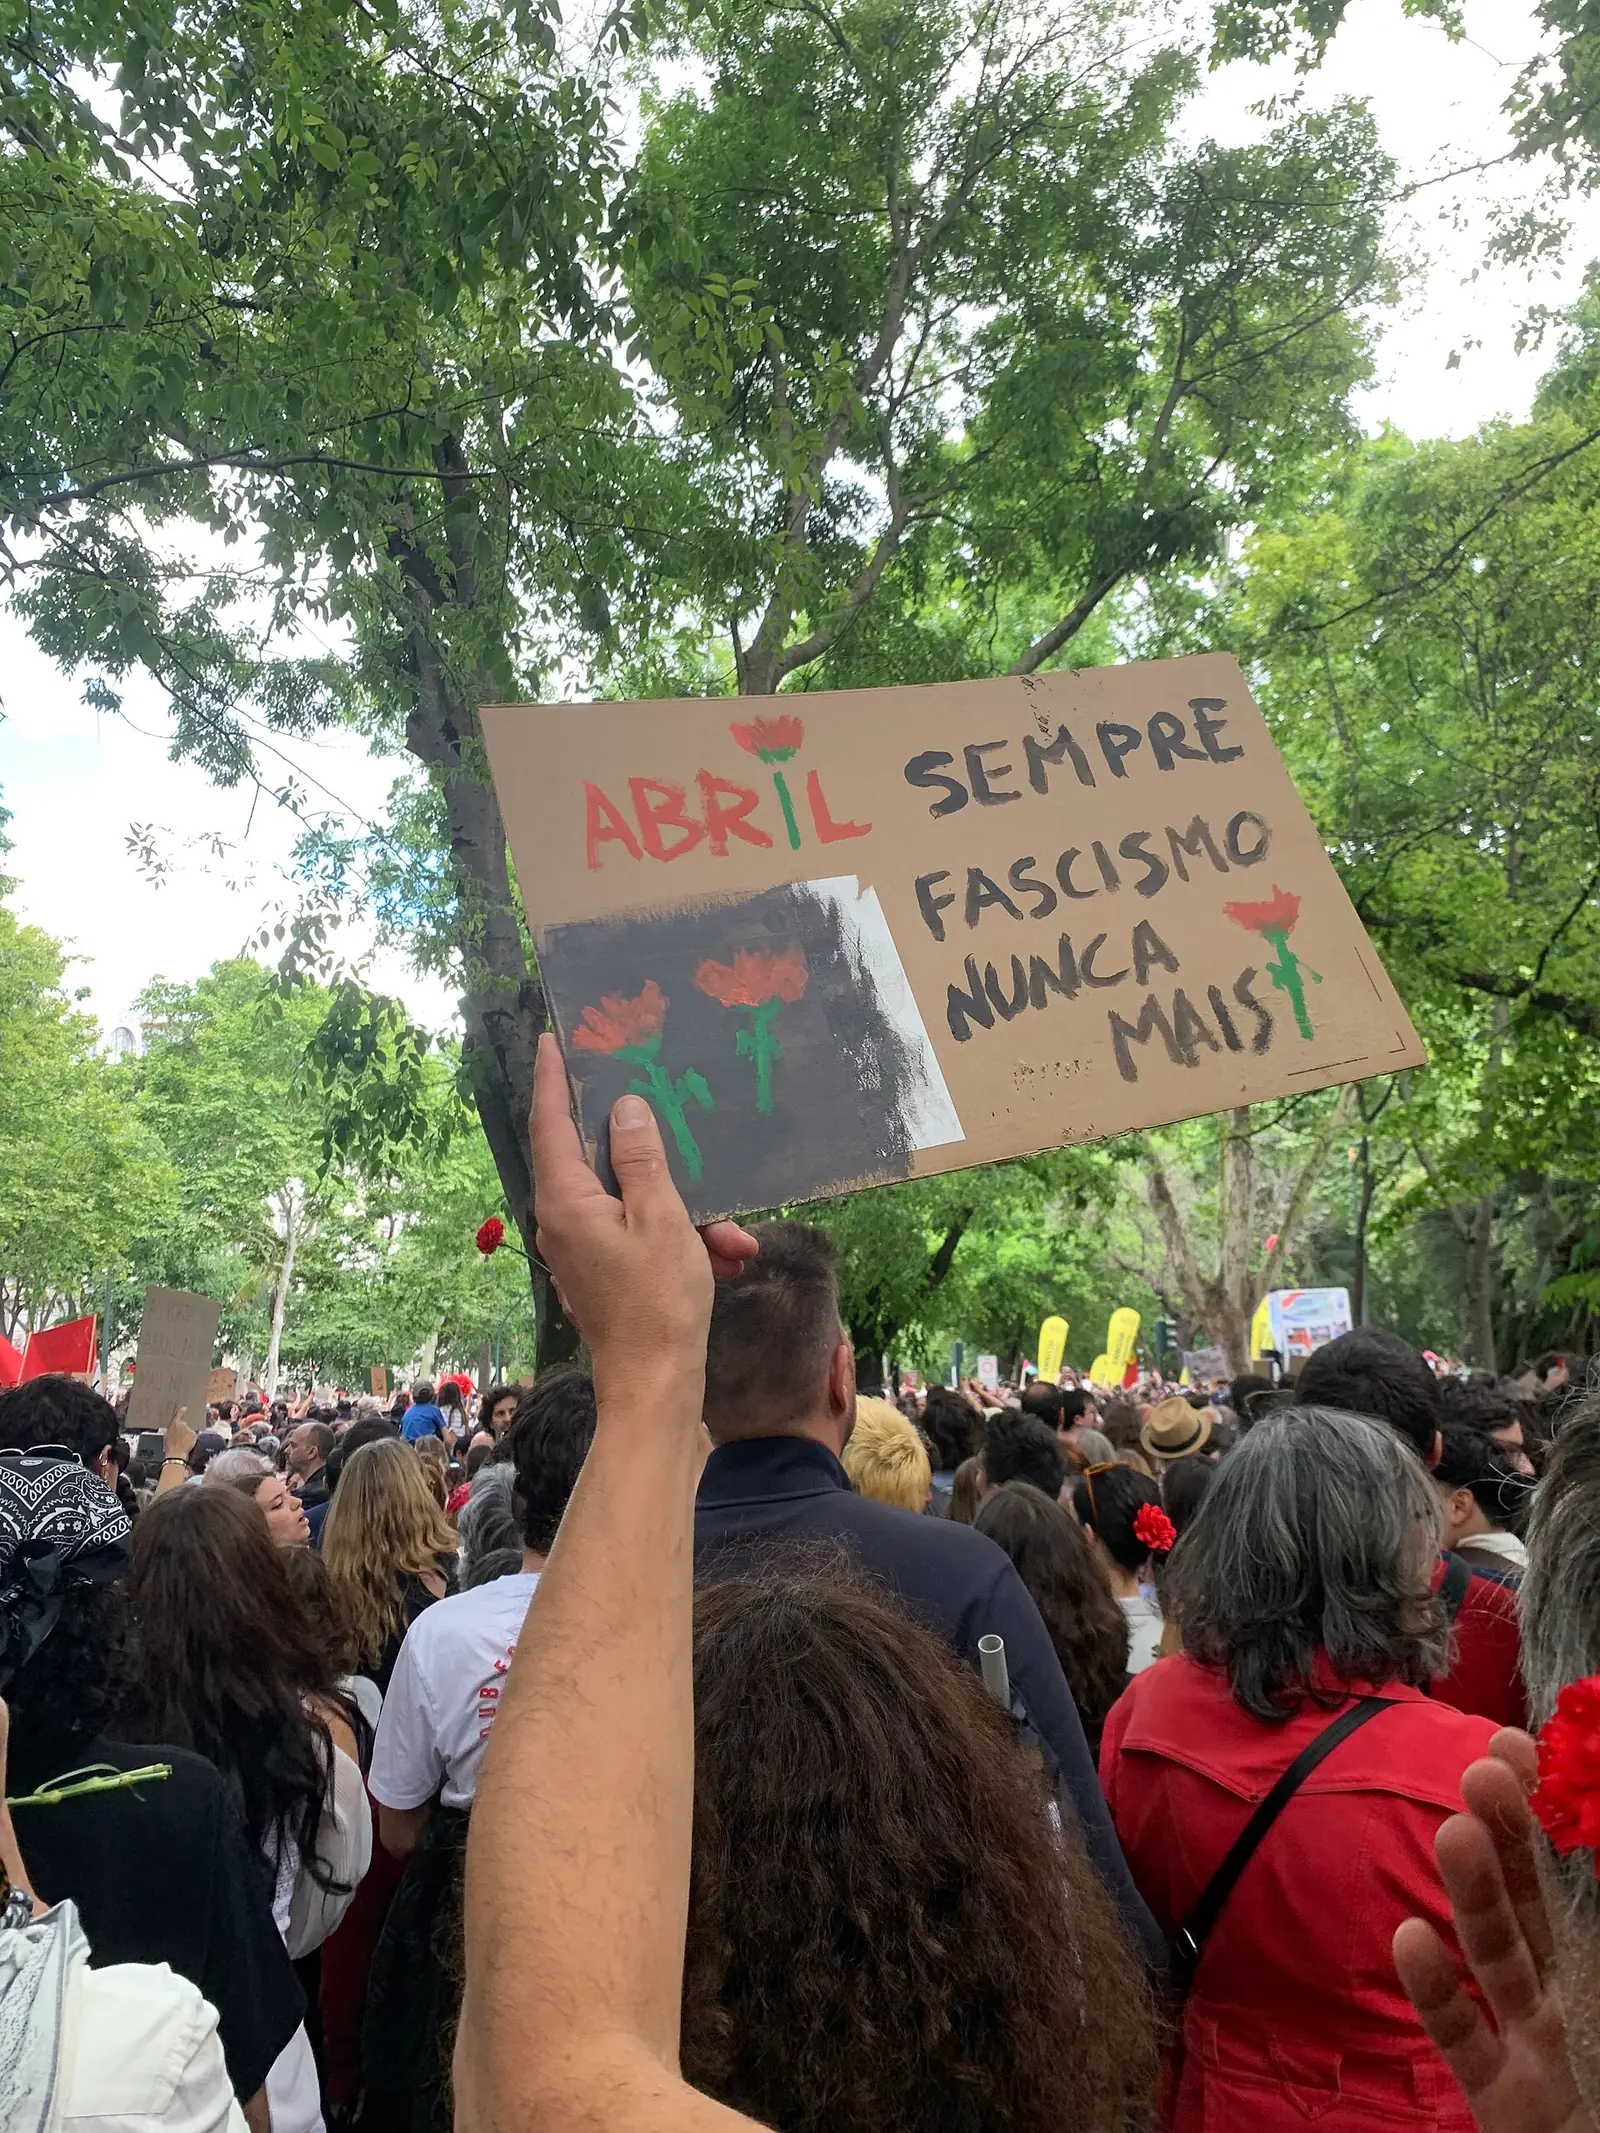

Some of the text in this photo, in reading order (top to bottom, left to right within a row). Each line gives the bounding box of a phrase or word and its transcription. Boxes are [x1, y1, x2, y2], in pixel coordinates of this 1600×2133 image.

[584, 697, 1245, 870] ABRIL SEMPRE
[914, 810, 1269, 941] FASCISMO
[945, 919, 1180, 1043] NUNCA
[1108, 967, 1274, 1083] MAIS
